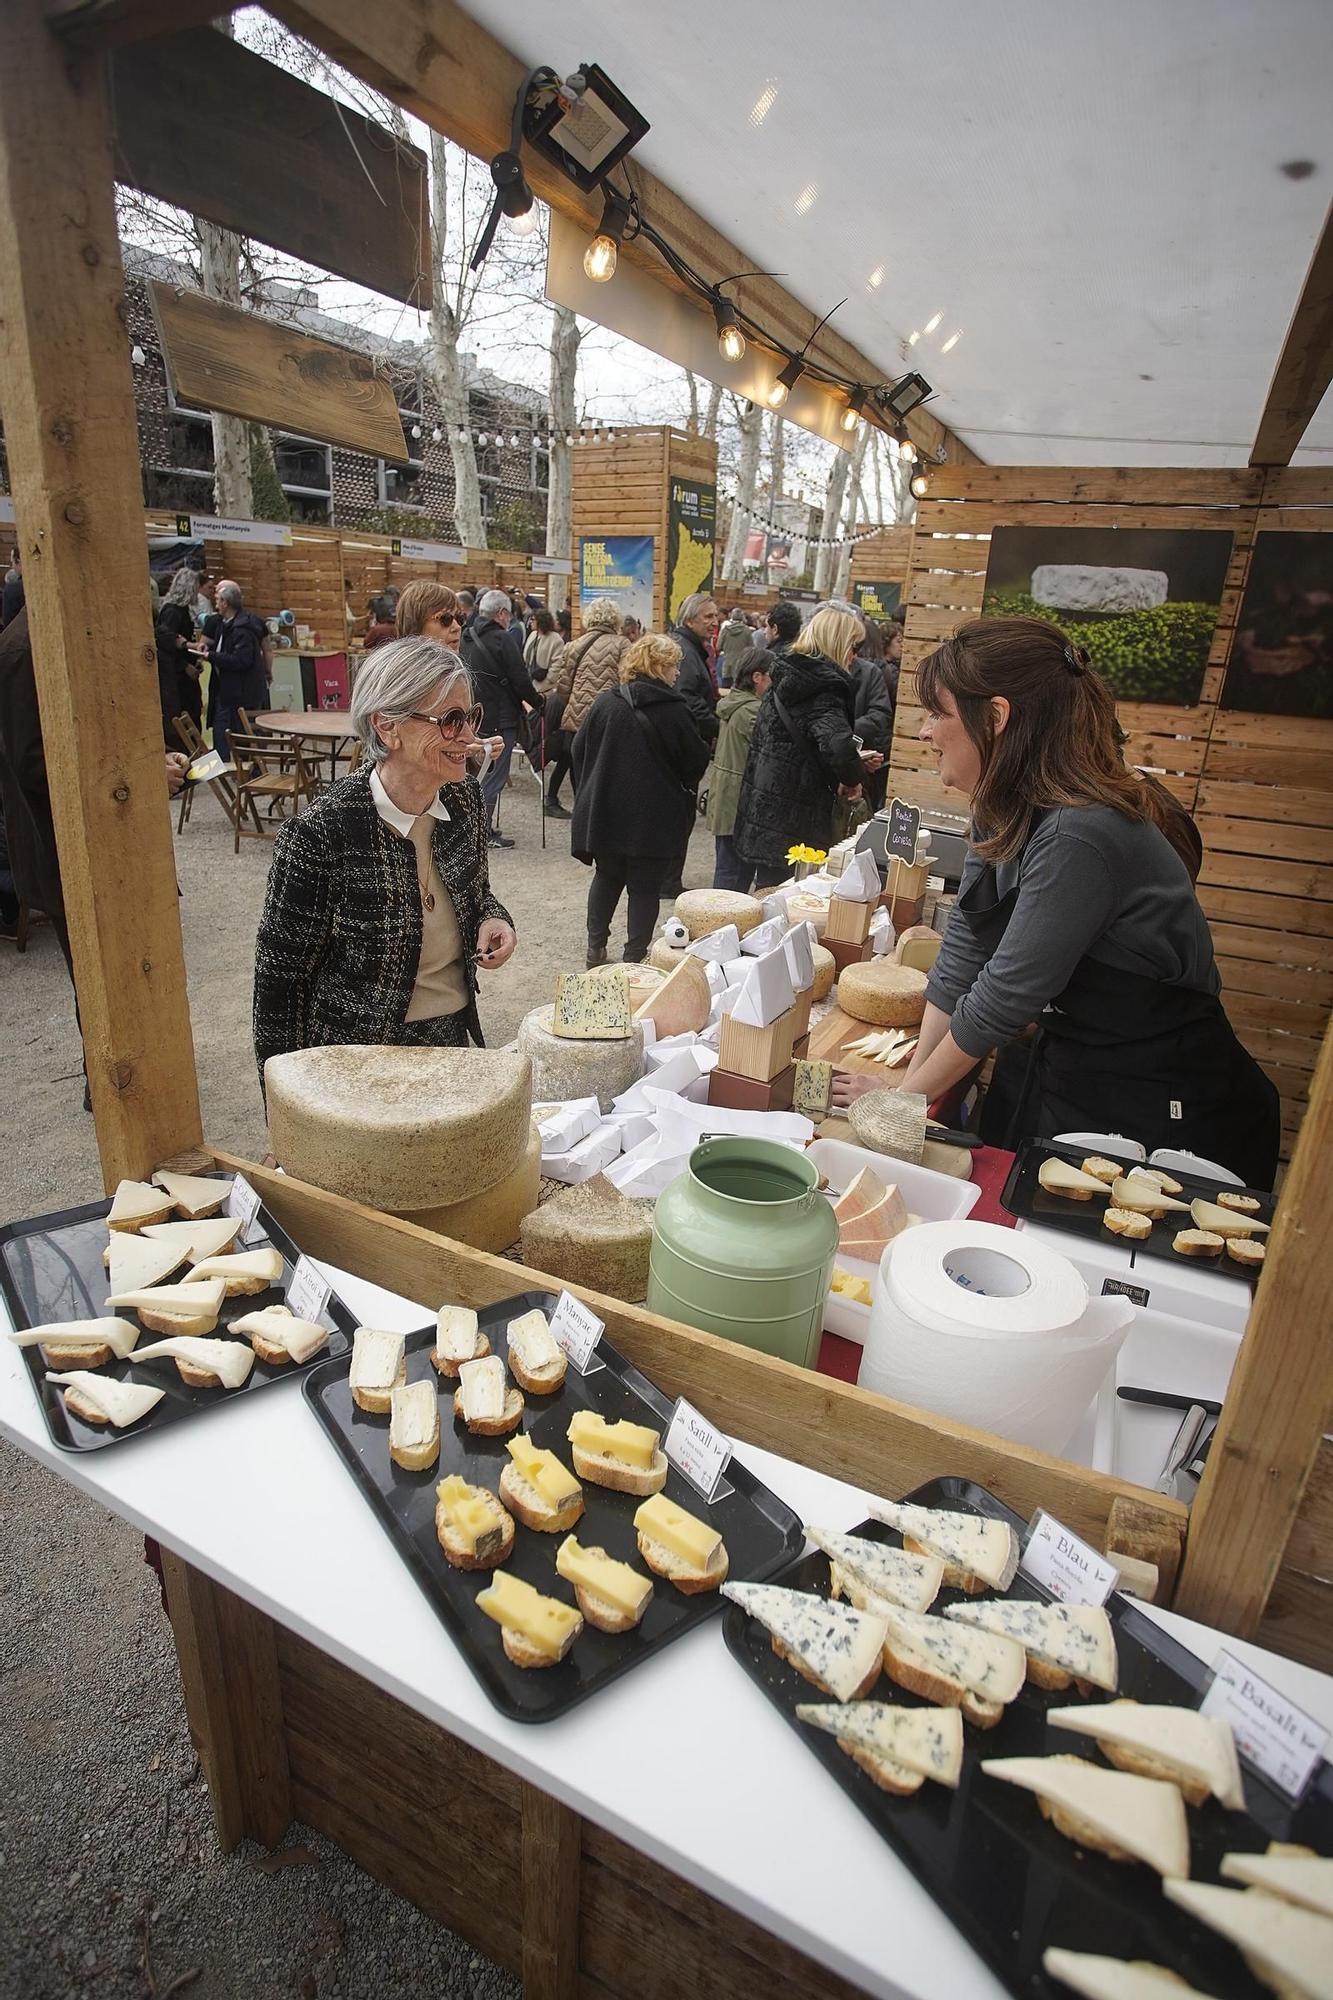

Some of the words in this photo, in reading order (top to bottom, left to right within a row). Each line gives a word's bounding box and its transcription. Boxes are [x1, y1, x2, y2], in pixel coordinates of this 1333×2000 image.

[179, 521, 189, 532] 42
[563, 1299, 592, 1334] Manyac
[688, 1419, 713, 1448] Saüll
[1056, 1536, 1089, 1572] Blau
[1241, 1680, 1297, 1737] Basalt
